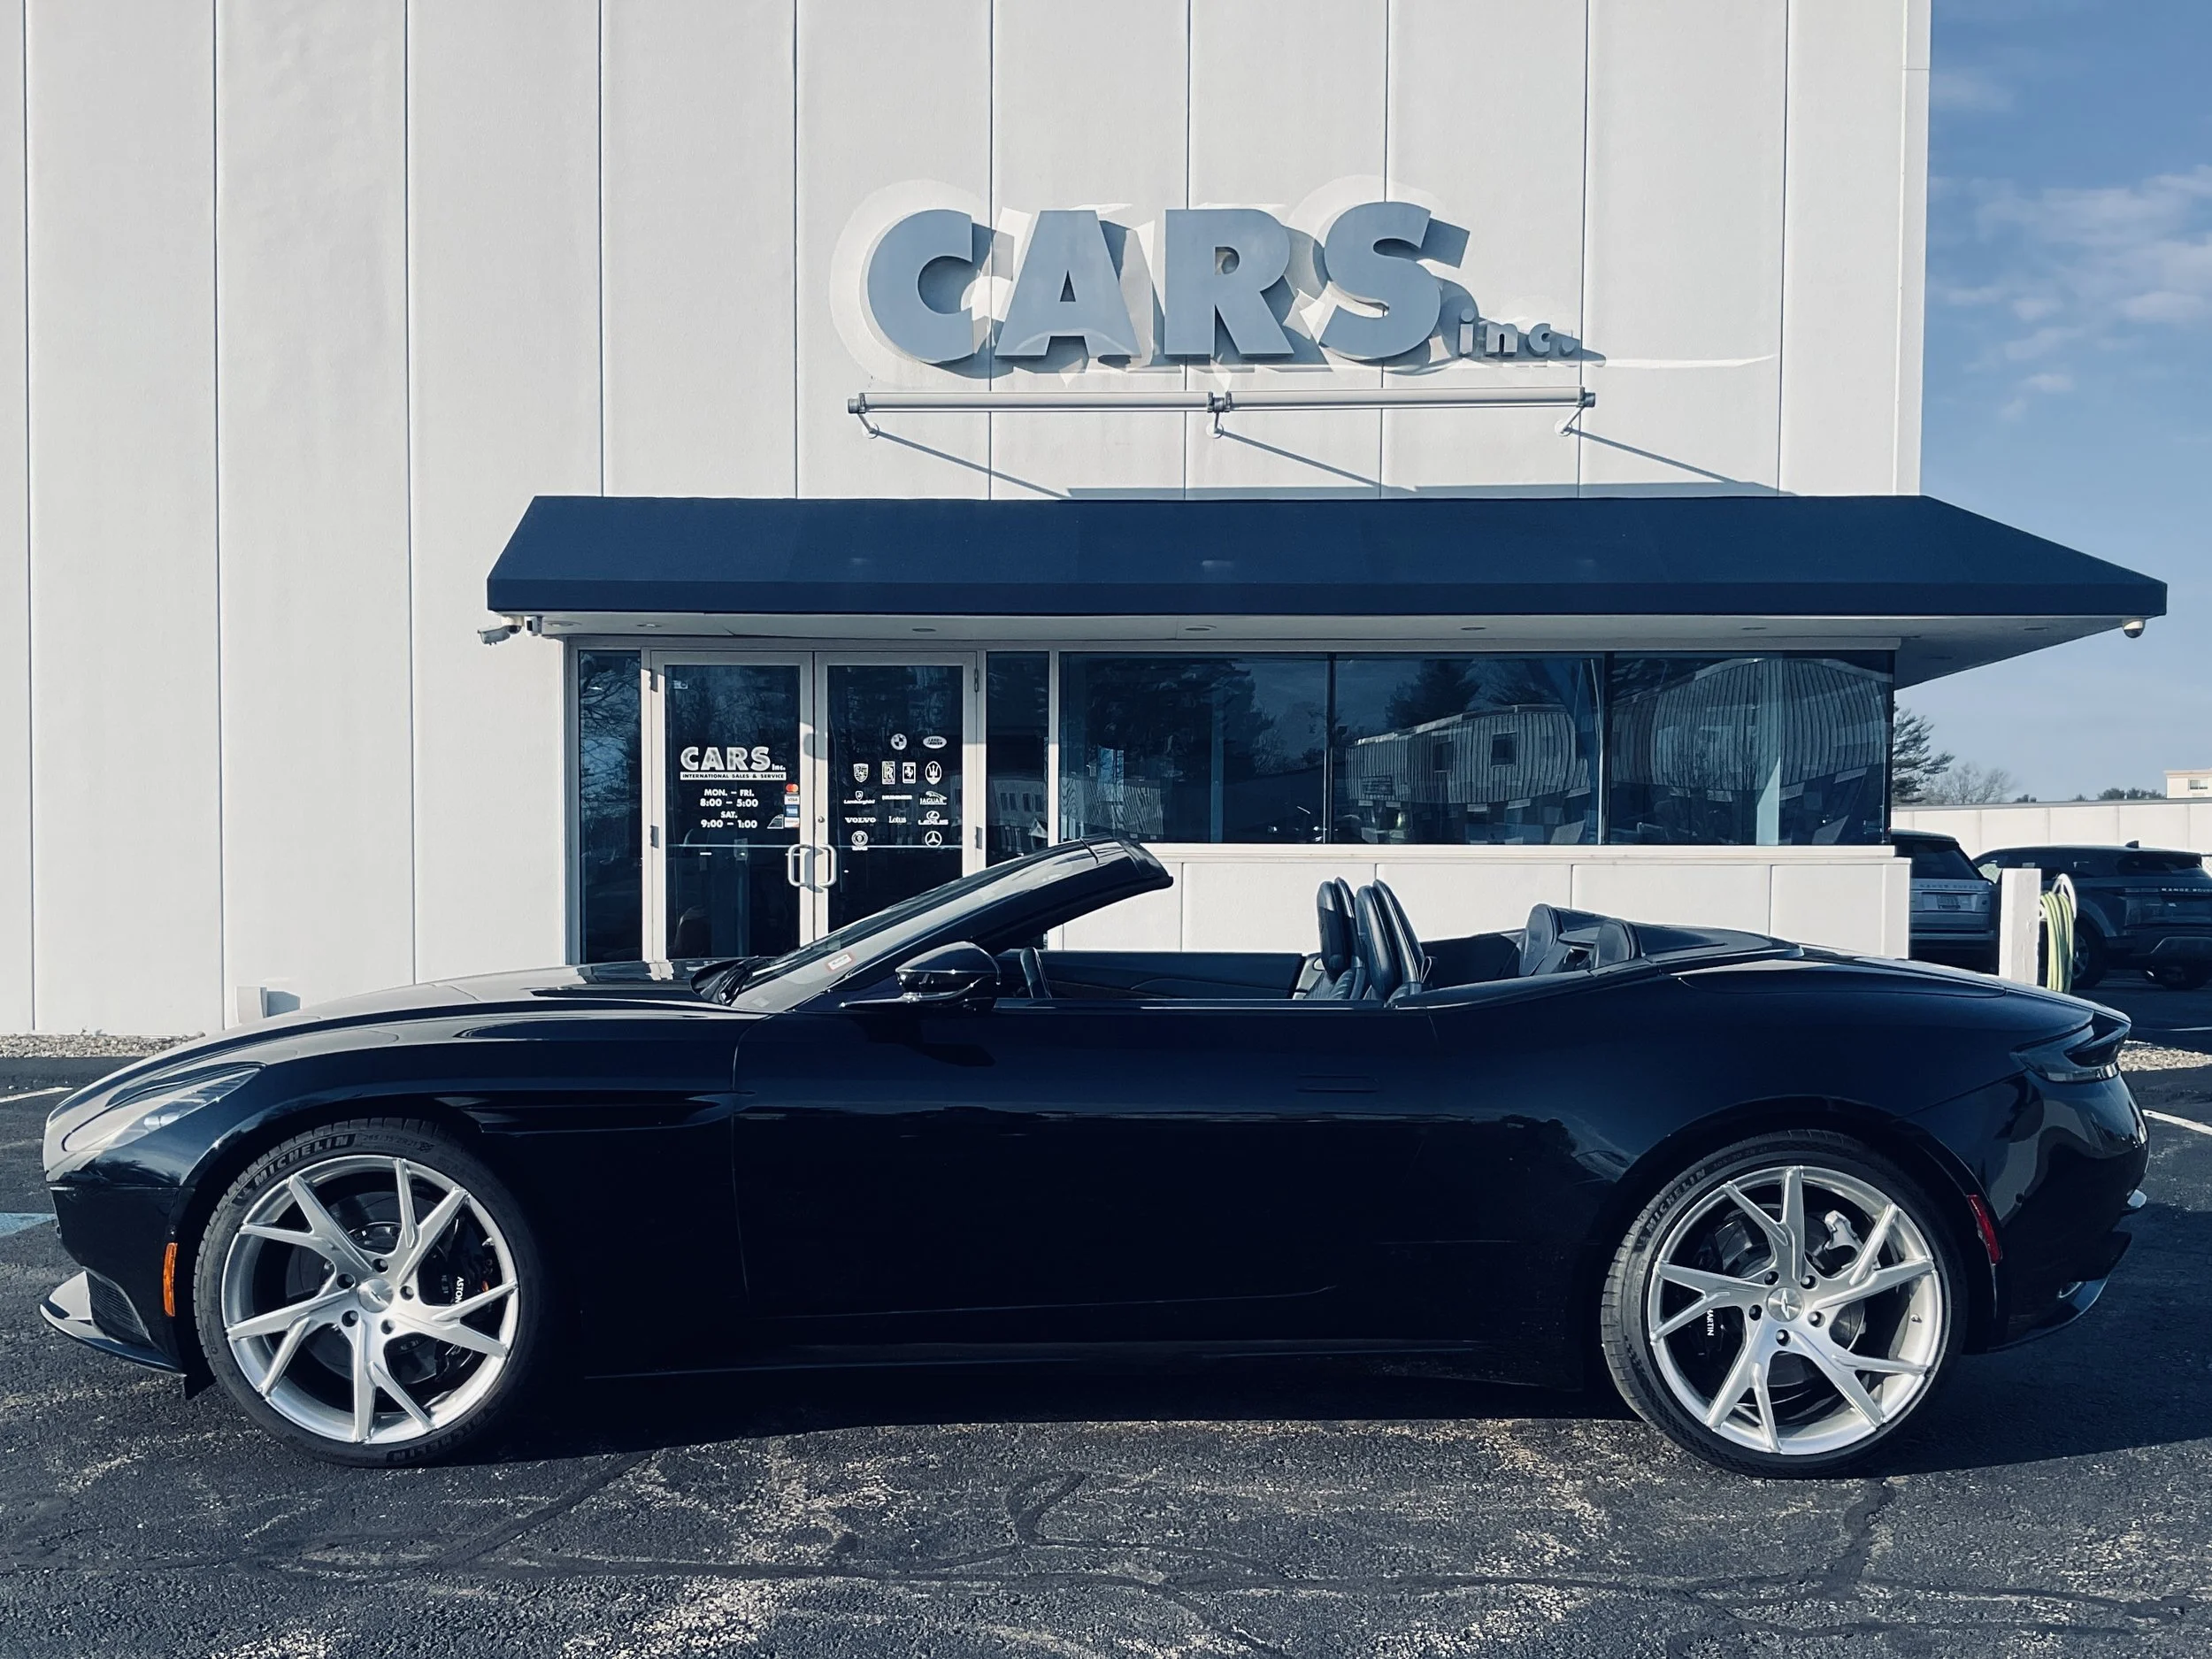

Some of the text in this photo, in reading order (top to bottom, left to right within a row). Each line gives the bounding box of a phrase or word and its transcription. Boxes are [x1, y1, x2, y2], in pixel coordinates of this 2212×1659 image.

[866, 202, 1576, 362] CARS inc.
[680, 747, 771, 771] CARS
[700, 798, 722, 807] 8:00
[736, 798, 758, 807] 5:00
[701, 819, 723, 828] 9:00
[738, 819, 758, 828] 1:00
[254, 1135, 349, 1187] MICHELIN
[1646, 1168, 1706, 1233] MICHELIN
[455, 1276, 465, 1302] ASTON
